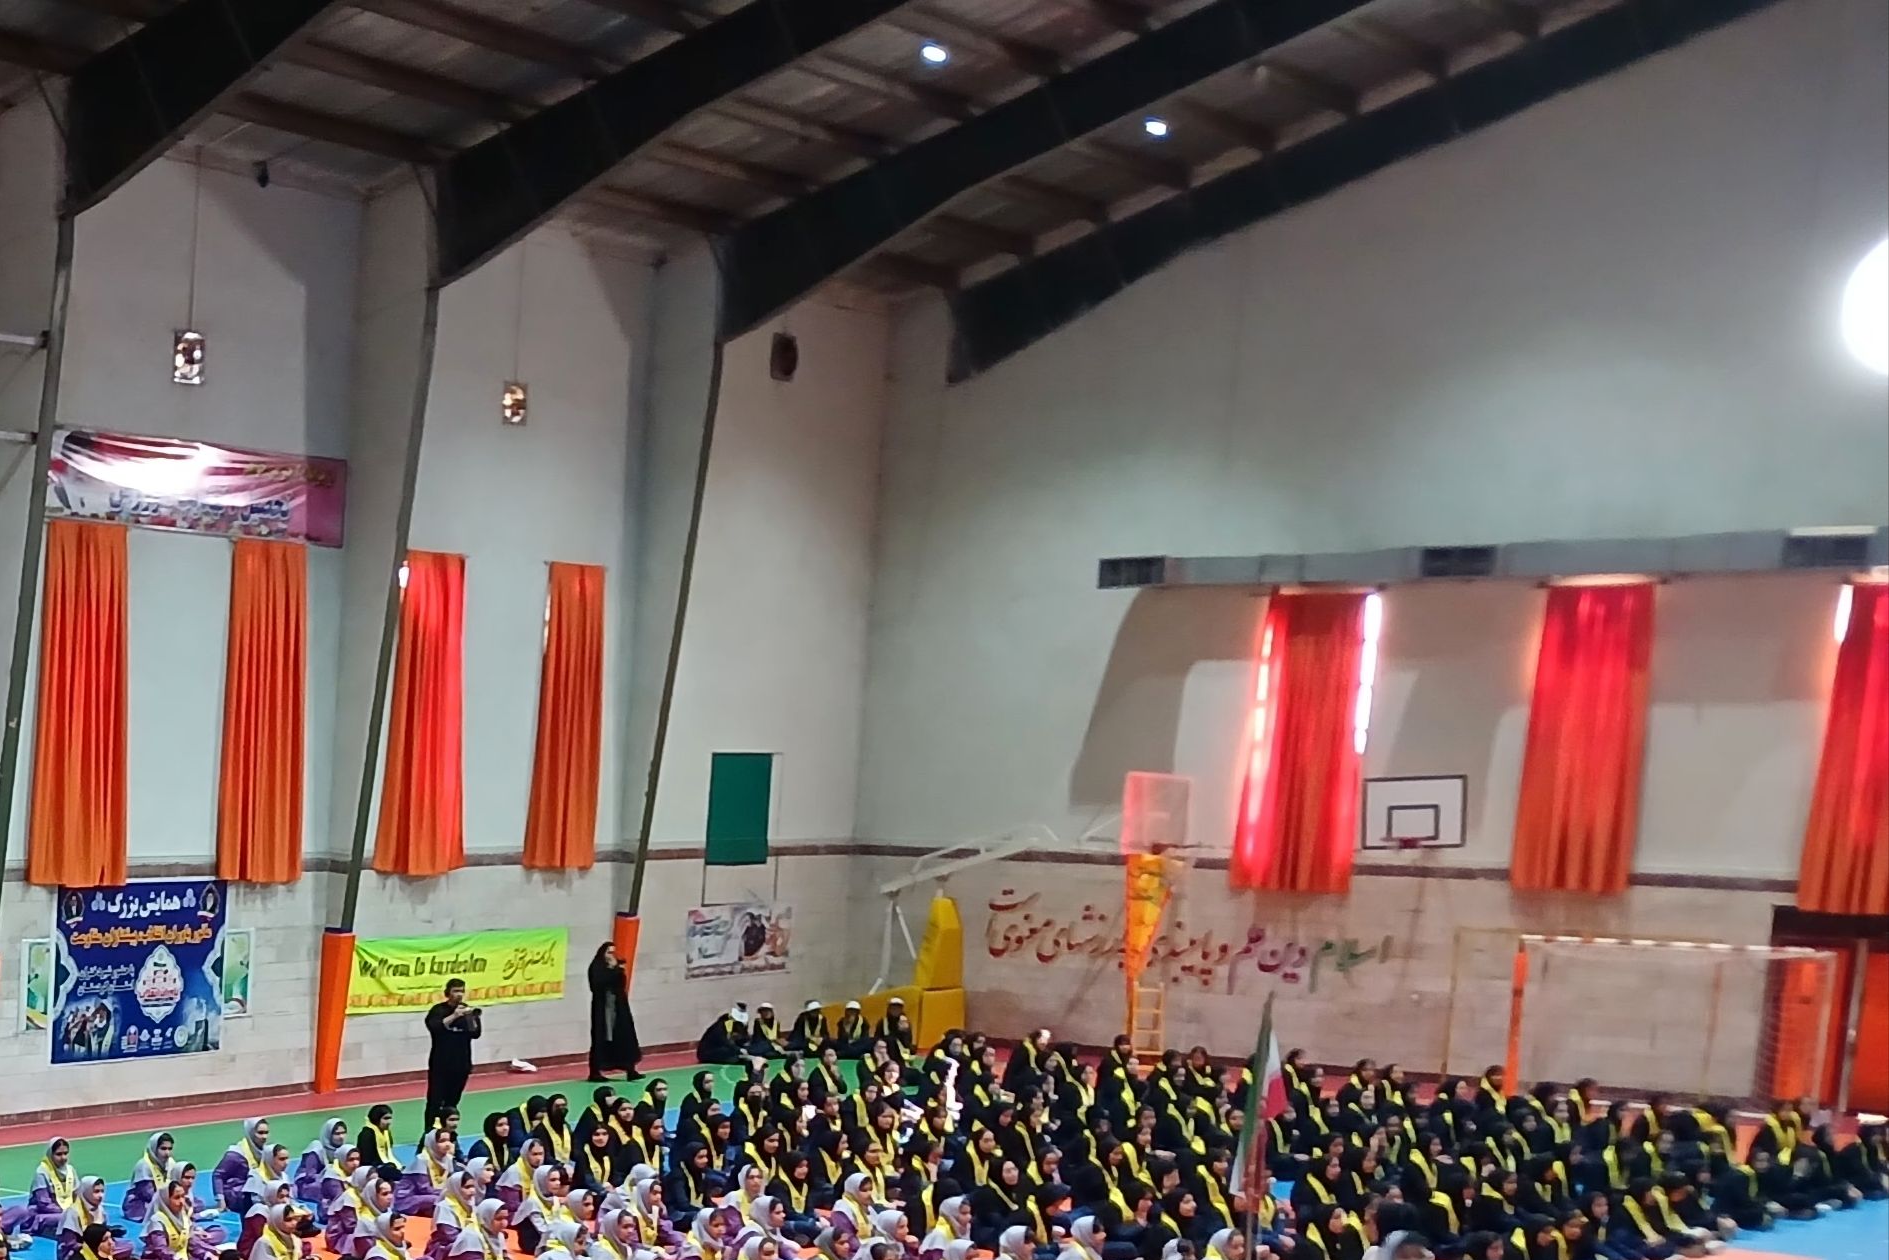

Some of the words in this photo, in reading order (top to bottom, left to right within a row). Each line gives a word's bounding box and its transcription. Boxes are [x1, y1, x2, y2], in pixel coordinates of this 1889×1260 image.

[107, 892, 139, 919] بزرگ
[140, 889, 181, 918] همایش
[1257, 941, 1307, 984] دین
[1308, 934, 1395, 994] اسلام
